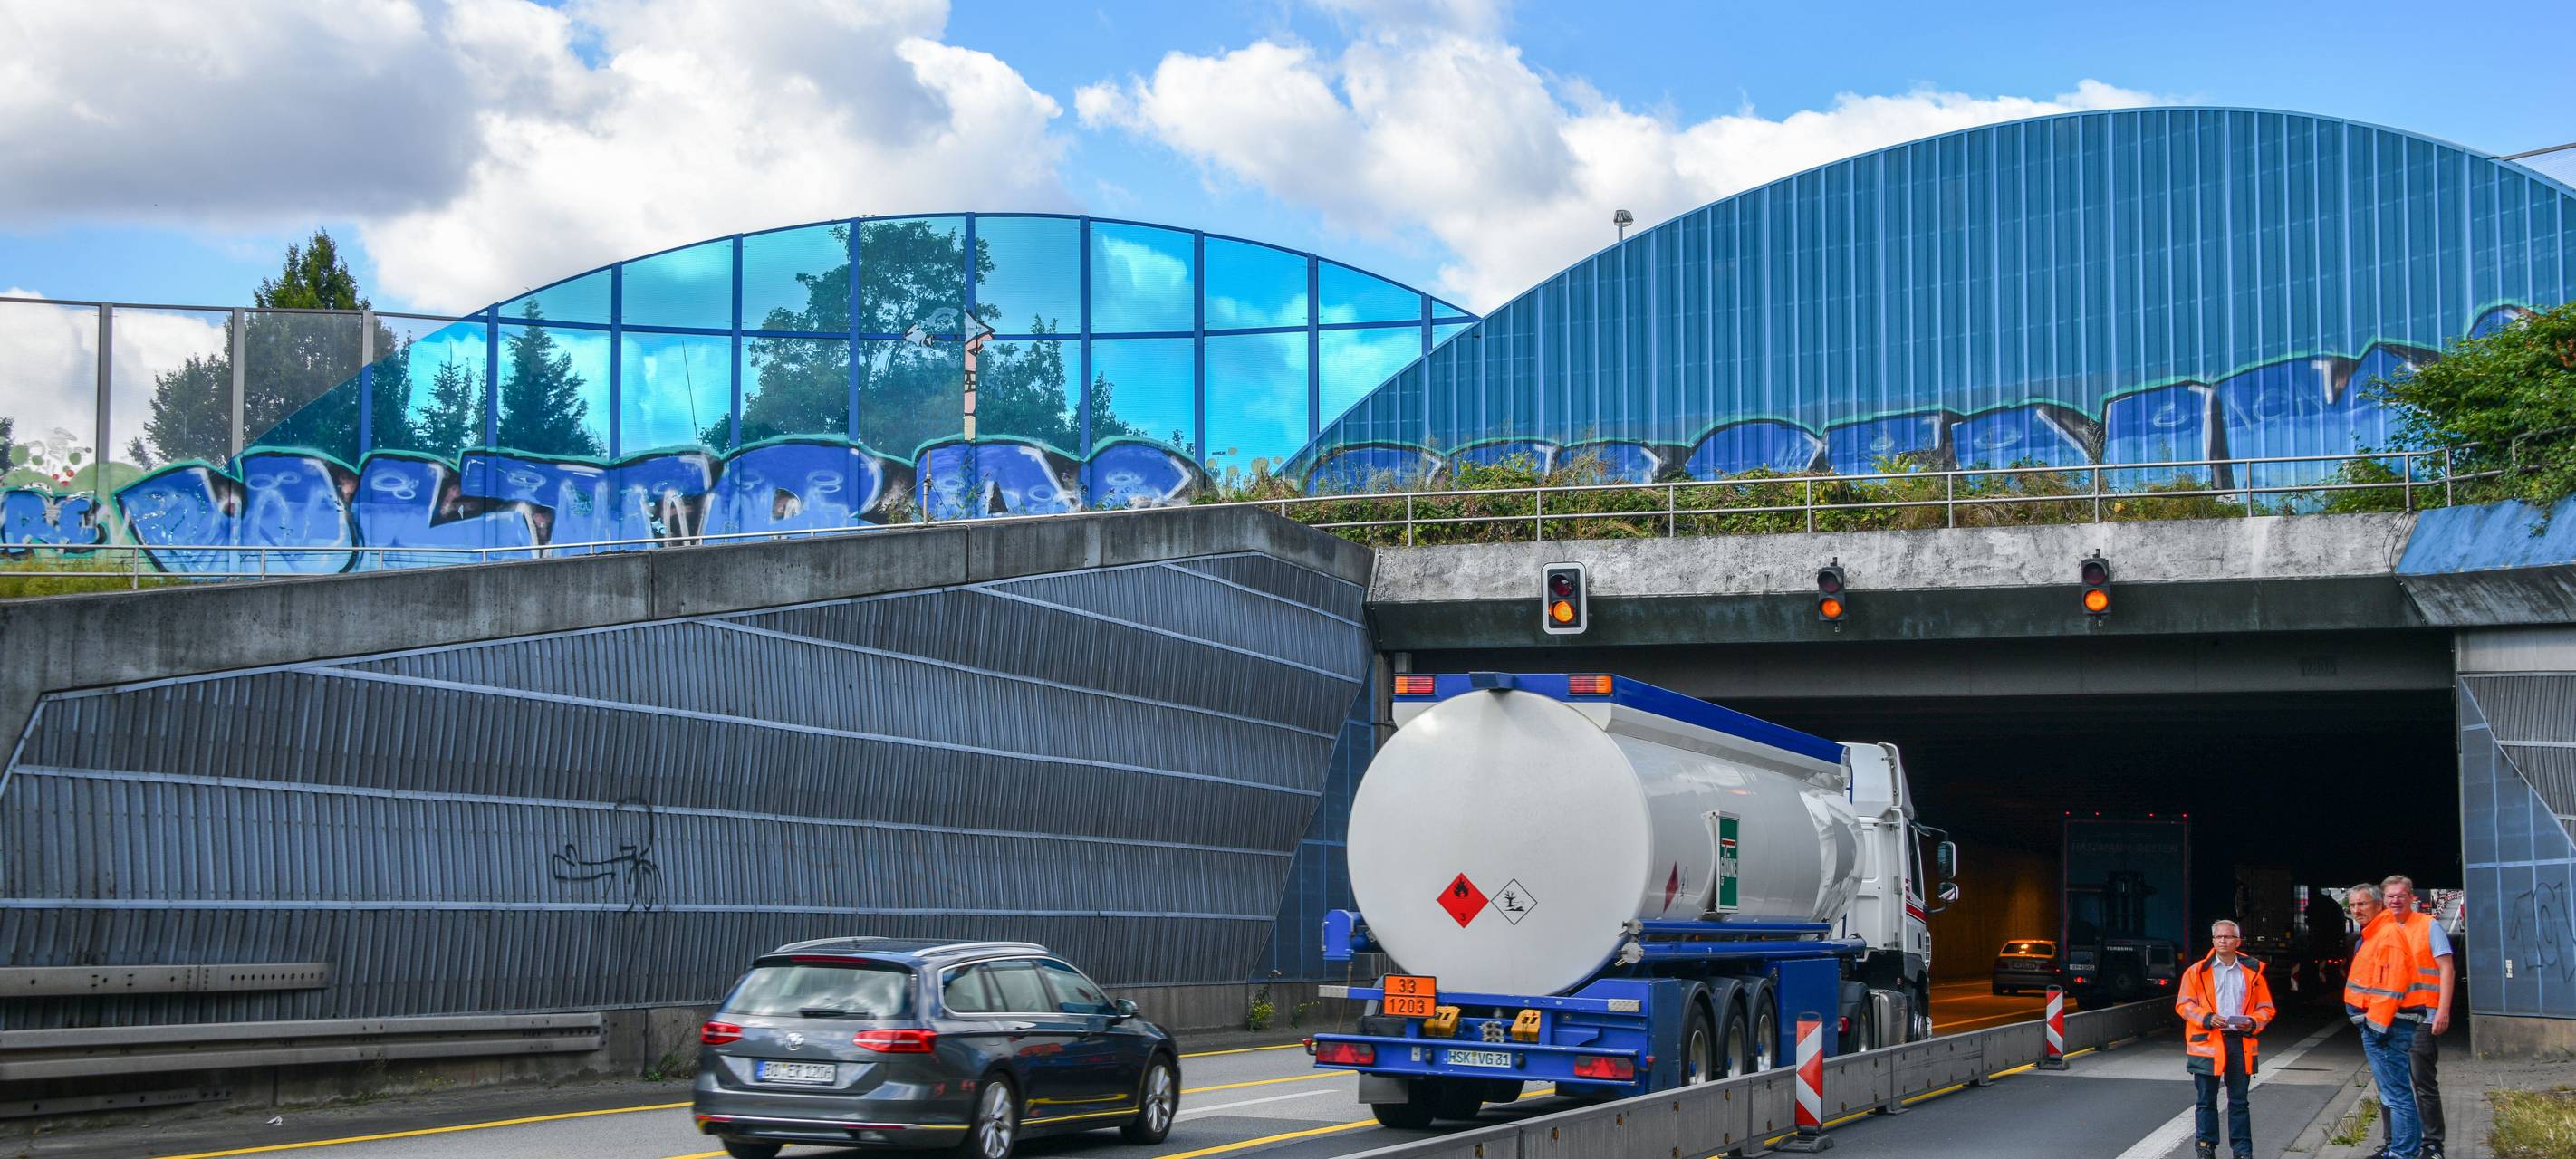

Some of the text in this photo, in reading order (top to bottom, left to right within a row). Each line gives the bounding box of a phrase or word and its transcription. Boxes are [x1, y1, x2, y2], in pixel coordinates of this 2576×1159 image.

[1460, 912, 1466, 921] 3
[1399, 979, 1416, 993] 33
[1389, 998, 1425, 1014] 1203
[1449, 1050, 1471, 1063] HSK
[1478, 1052, 1493, 1065] VG
